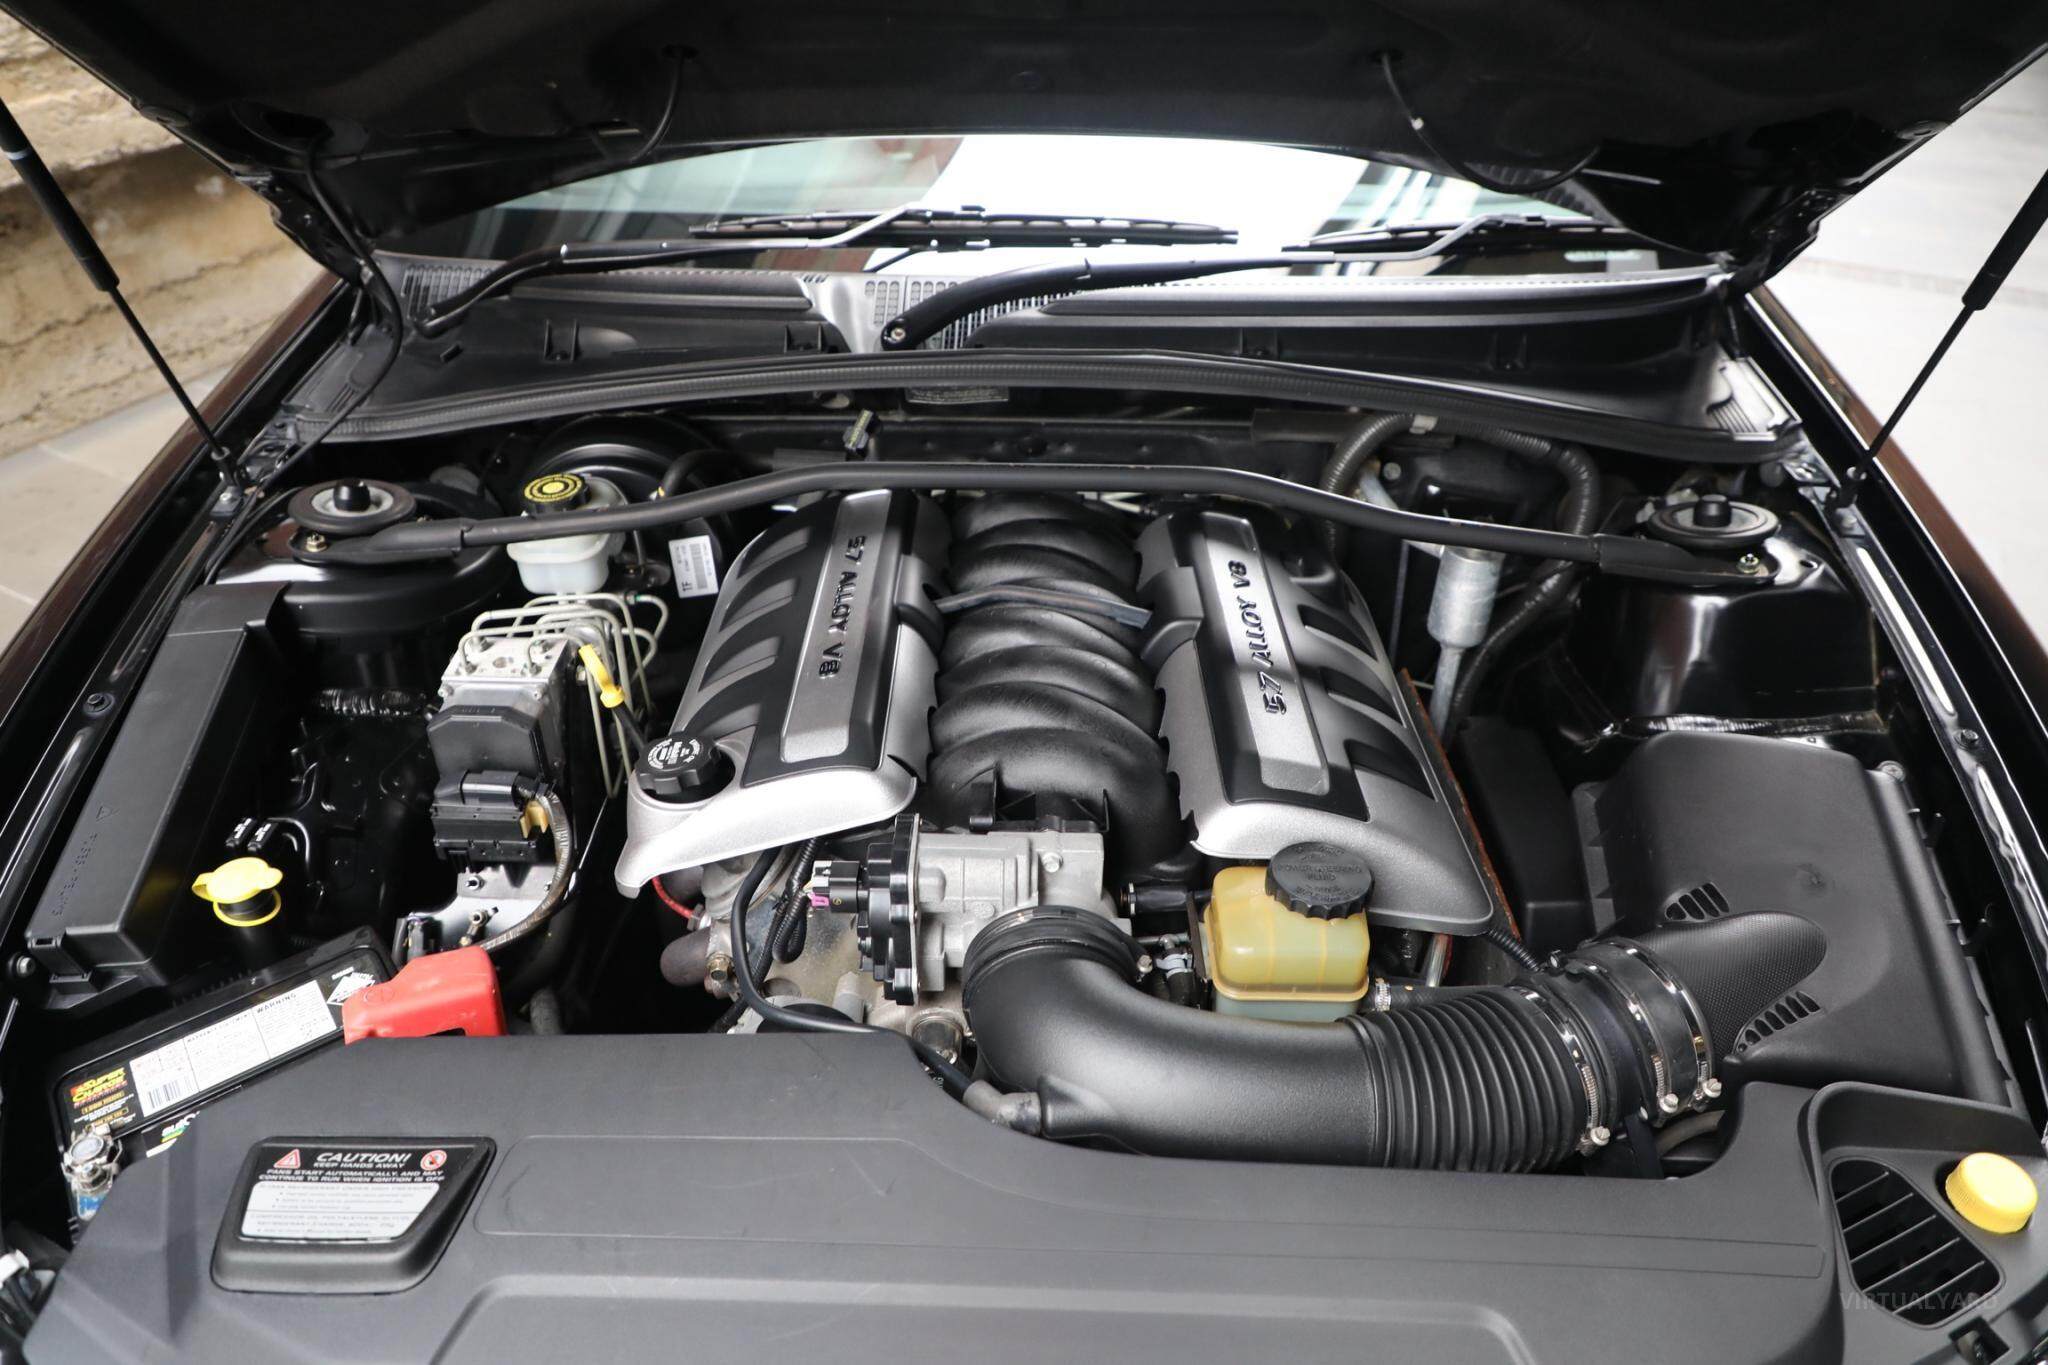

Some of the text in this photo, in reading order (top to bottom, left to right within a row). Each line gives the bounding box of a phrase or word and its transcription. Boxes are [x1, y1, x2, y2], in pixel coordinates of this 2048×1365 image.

[1228, 560, 1251, 589] V8
[828, 571, 858, 634] ALLOY
[1236, 595, 1274, 668] ALLOY
[818, 642, 846, 679] V8
[316, 1152, 412, 1163] CAUTION!
[342, 1175, 371, 1183] WHEN
